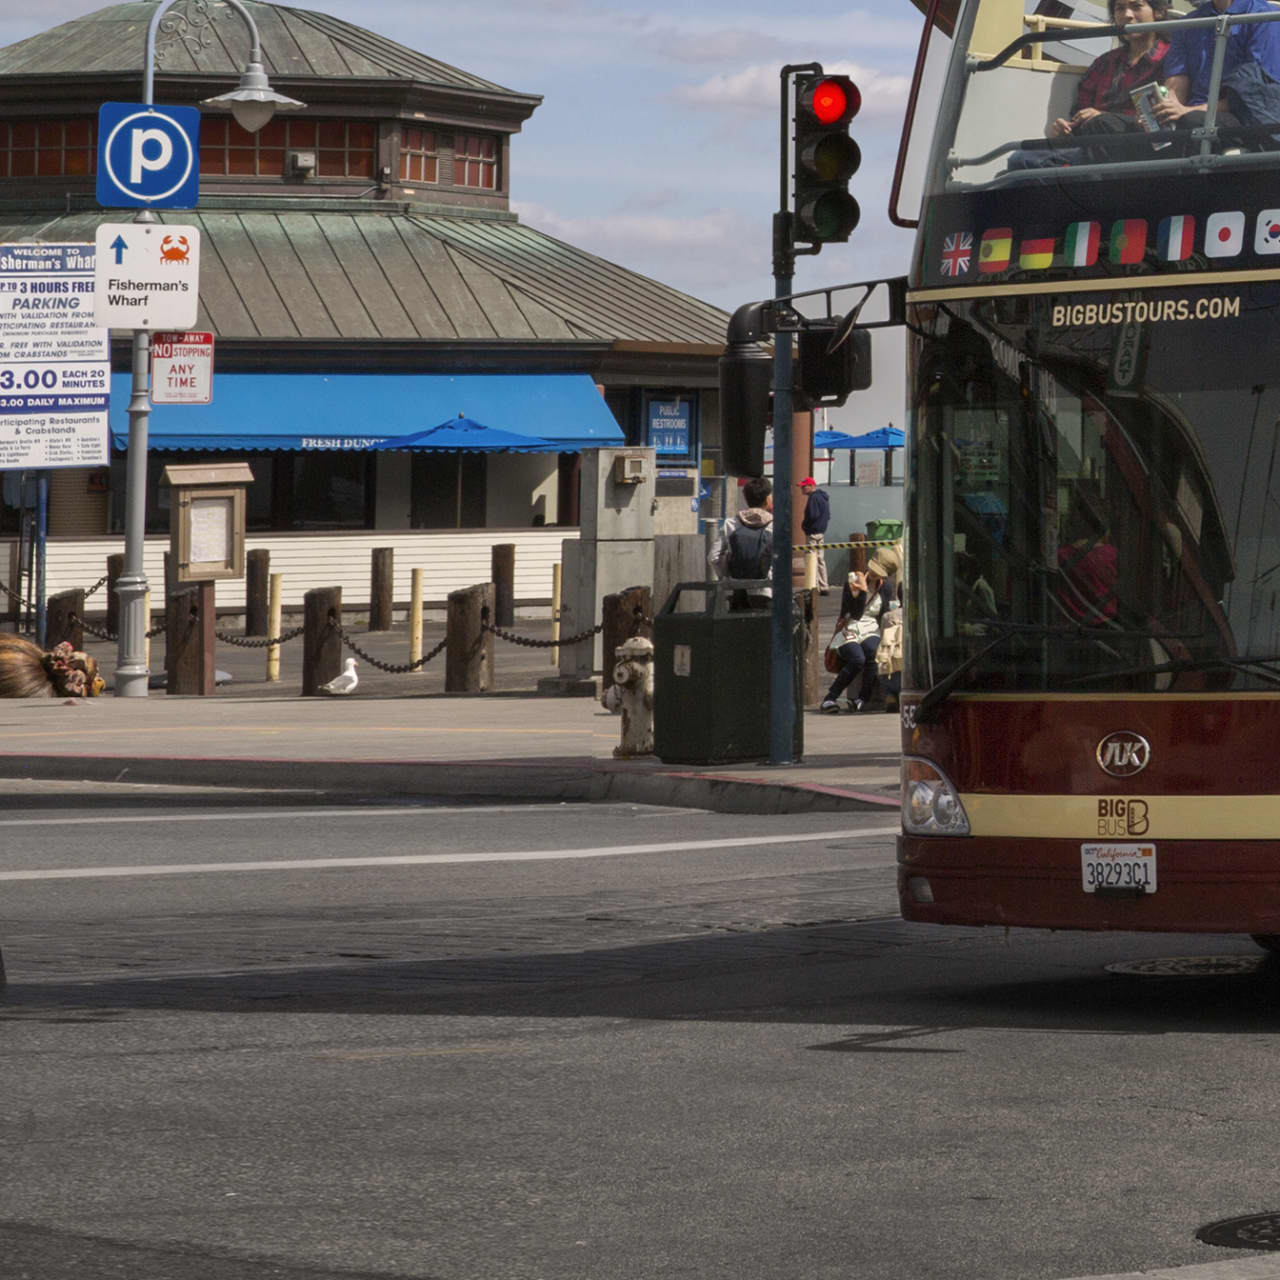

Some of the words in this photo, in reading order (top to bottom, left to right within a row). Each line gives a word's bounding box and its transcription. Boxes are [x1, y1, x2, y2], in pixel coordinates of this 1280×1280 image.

[13, 247, 63, 257] WELCOME
[67, 248, 80, 256] TO
[7, 281, 18, 291] TO
[20, 281, 28, 294] 3
[30, 281, 69, 294] HOURS
[108, 278, 189, 292] Fisherman's
[12, 296, 81, 311] PARKING
[107, 294, 149, 307] Wharf
[21, 311, 68, 320] VALIDATION
[71, 311, 95, 319] FROM
[1052, 296, 1241, 327] BIGBUSTOURS.COM
[10, 341, 28, 349] FREE
[32, 340, 53, 349] WITH
[56, 340, 104, 348] VALIDATION
[163, 334, 205, 343] TOW-AWAY
[14, 350, 68, 359] CRABSTANDS
[154, 343, 171, 357] NO
[173, 347, 211, 358] STOPPING
[62, 370, 88, 378] EACH
[90, 369, 106, 378] 20
[169, 363, 196, 375] ANY
[62, 379, 106, 389] MINUTES
[167, 376, 197, 389] TIME
[27, 397, 56, 407] DAILY
[58, 396, 106, 406] MAXIMUM
[658, 405, 680, 417] PUBLIC
[49, 416, 101, 425] Restaurants
[652, 418, 687, 430] RESTROOMS
[25, 425, 76, 436] Crabstands
[302, 437, 341, 449] FRESH
[1097, 799, 1126, 818] BIG
[1097, 818, 1126, 836] BUS
[1095, 846, 1138, 863] California
[1086, 861, 1152, 886] 38293C1
